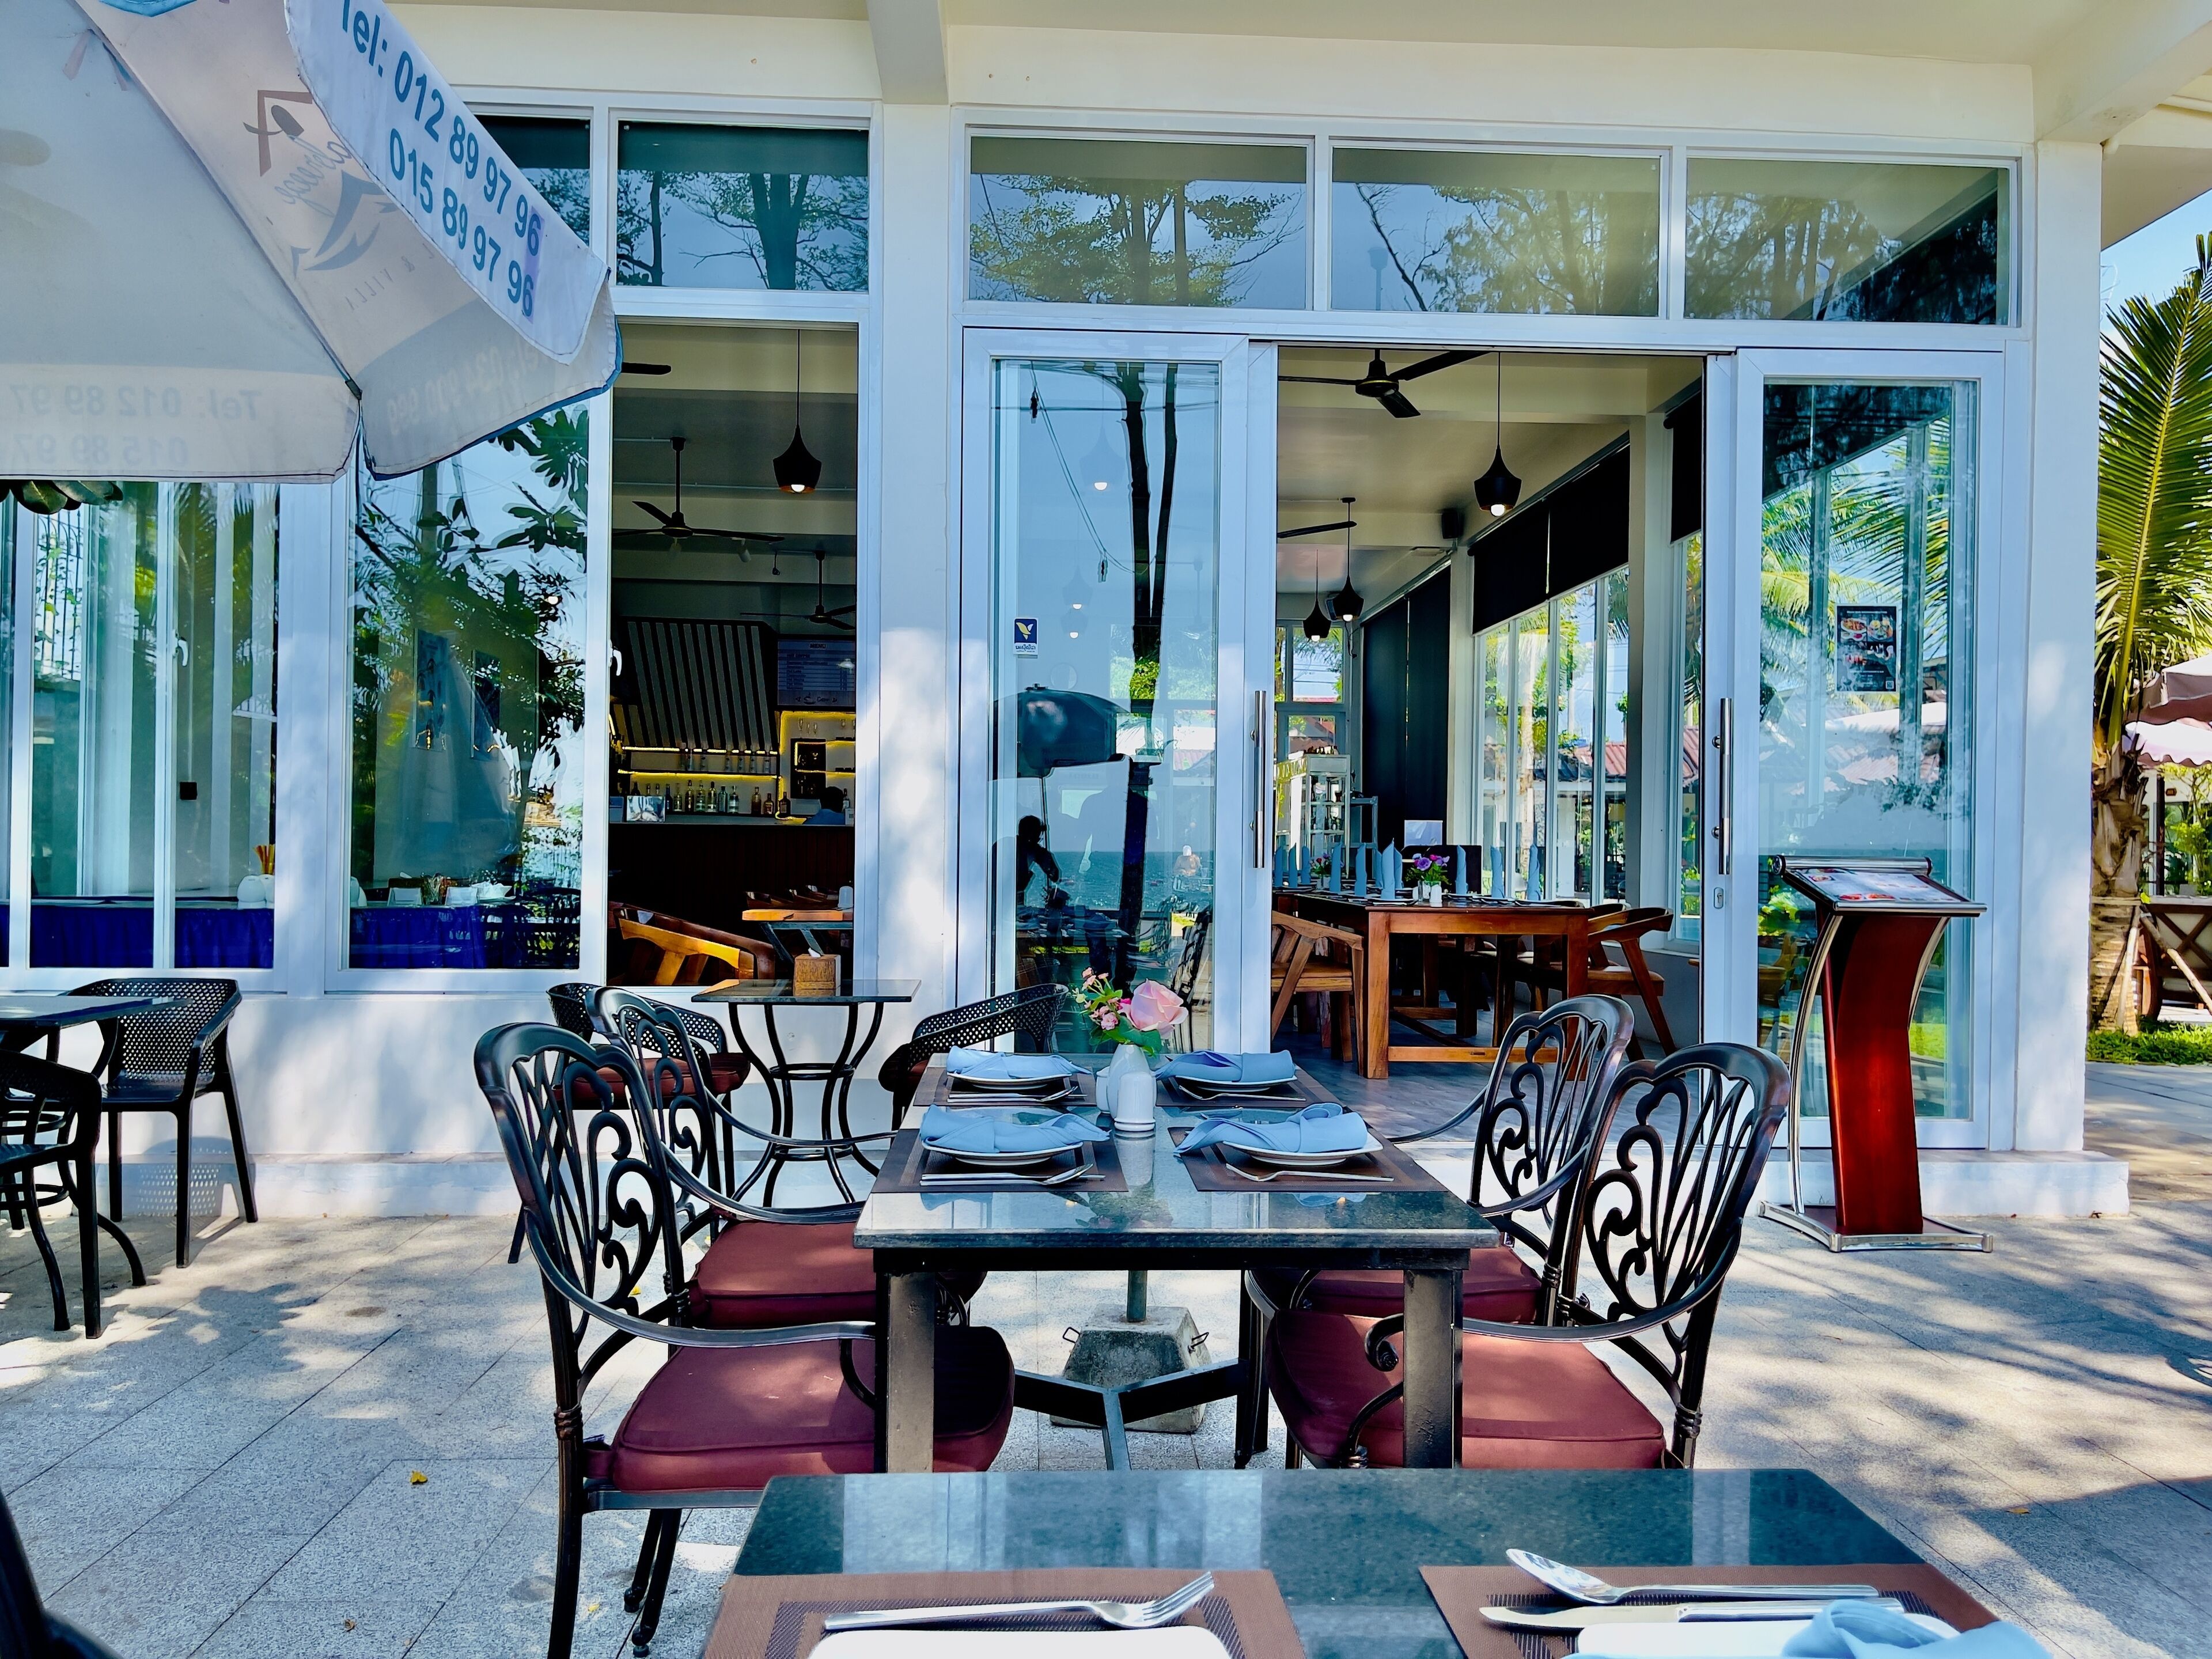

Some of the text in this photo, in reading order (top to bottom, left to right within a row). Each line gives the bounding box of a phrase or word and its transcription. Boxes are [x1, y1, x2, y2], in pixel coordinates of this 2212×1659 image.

[389, 128, 433, 214] 015
[442, 187, 468, 250] 89
[473, 225, 501, 282] 97
[507, 260, 534, 317] 96
[395, 50, 445, 143] 012
[449, 115, 479, 179] 89
[483, 156, 512, 214] 97
[514, 194, 541, 256] 96
